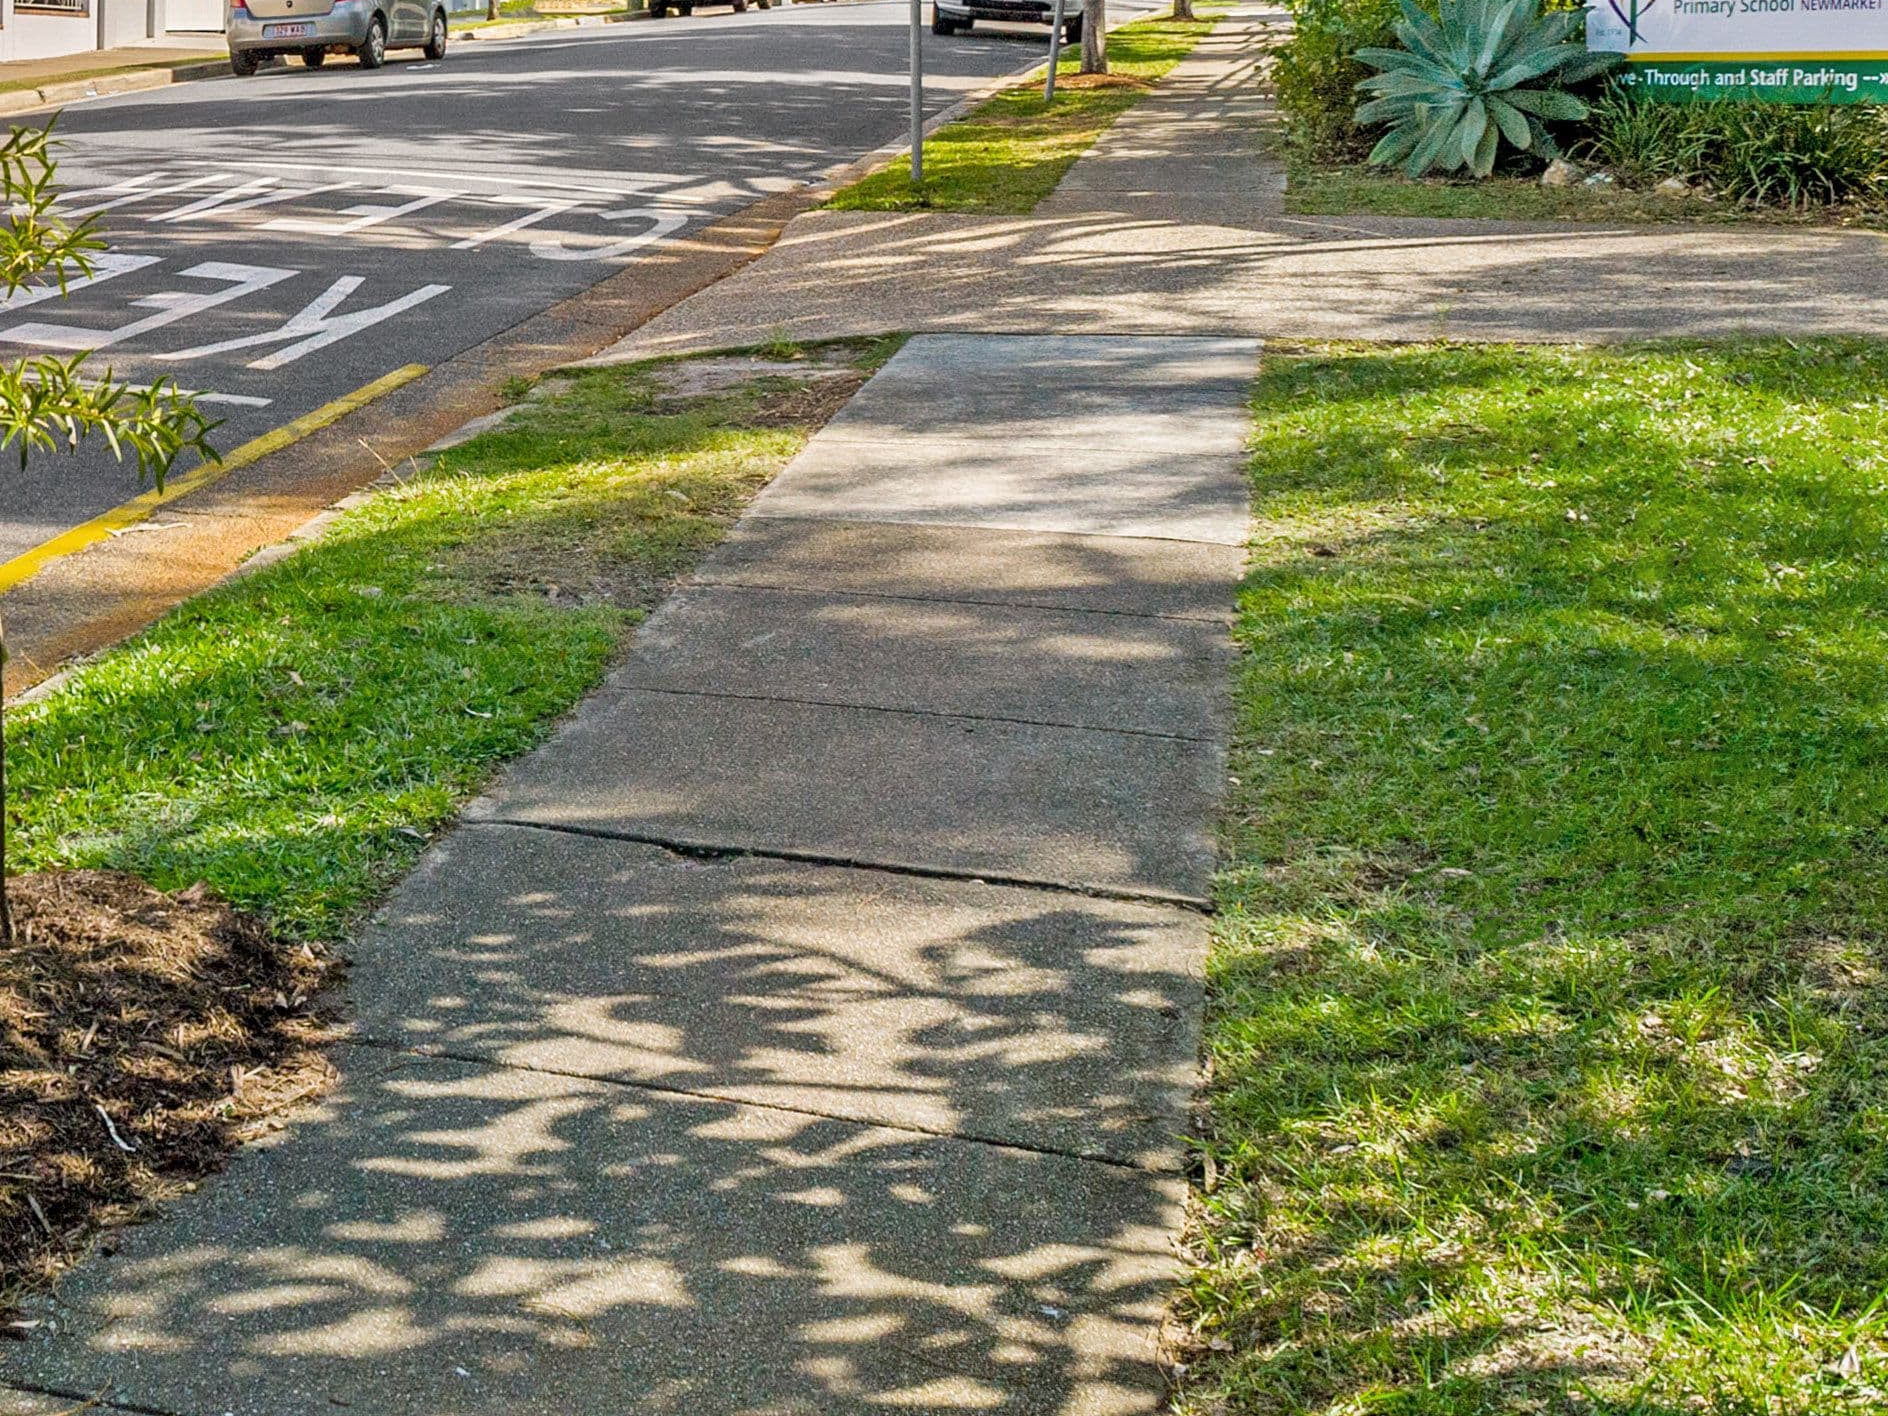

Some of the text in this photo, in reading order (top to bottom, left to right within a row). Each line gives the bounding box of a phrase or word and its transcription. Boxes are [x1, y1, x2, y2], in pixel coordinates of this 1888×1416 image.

[1715, 69, 1746, 85] and
[1750, 67, 1788, 86] Staff
[1793, 67, 1858, 91] Parking
